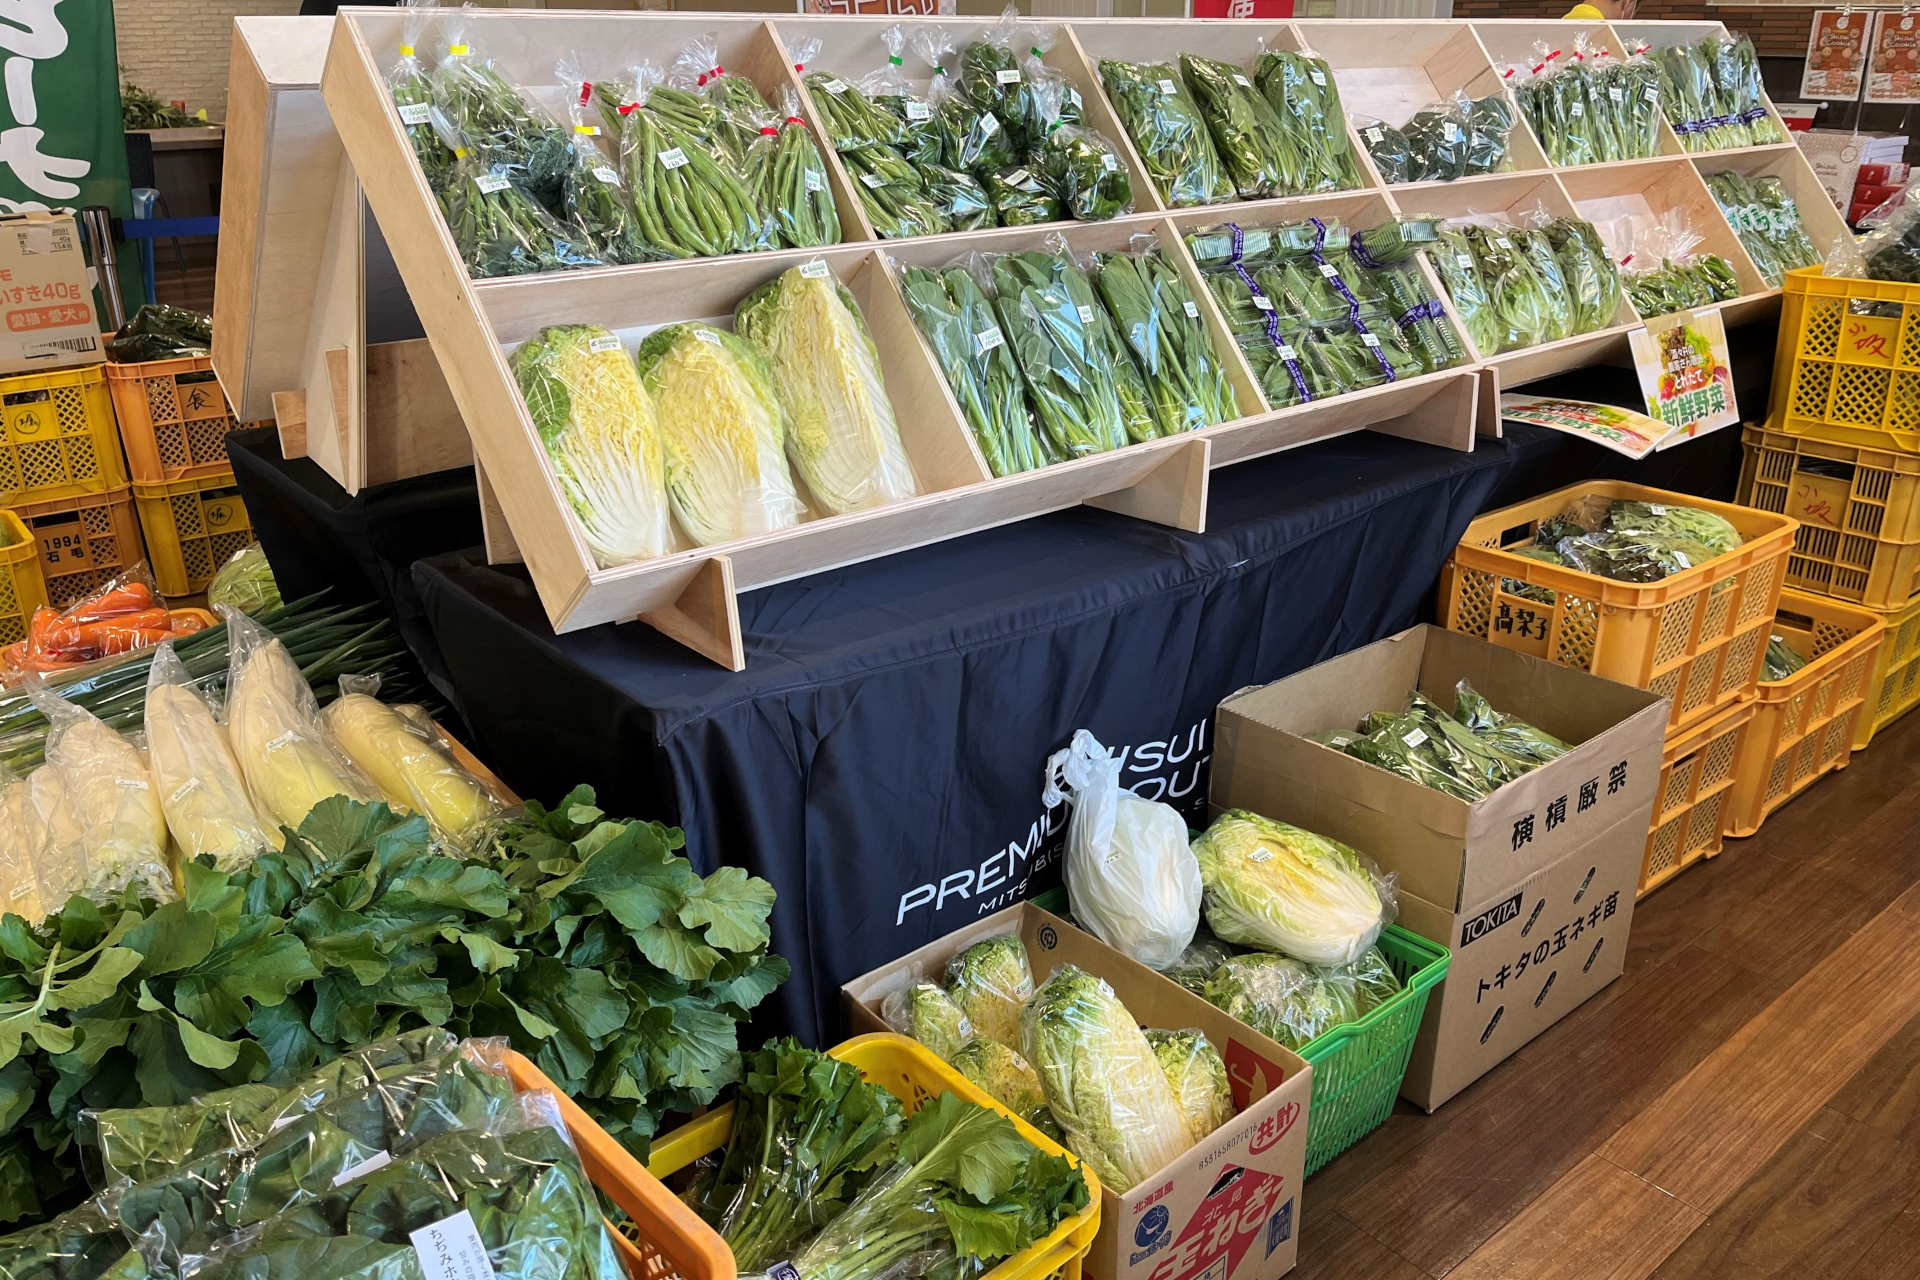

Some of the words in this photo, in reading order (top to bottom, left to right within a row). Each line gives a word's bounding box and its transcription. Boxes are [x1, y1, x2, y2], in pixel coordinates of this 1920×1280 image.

[1675, 369, 1704, 390] とれたて
[1661, 384, 1726, 426] 新鮮野菜
[44, 534, 81, 551] 1994
[1466, 900, 1519, 945] TOKITA
[1476, 891, 1620, 1004] トキタの玉ネギ苗
[1257, 1102, 1294, 1147] 共計
[1133, 1180, 1174, 1215] 北海道産
[1202, 1186, 1243, 1227] 北見
[429, 1229, 460, 1280] ちぢみホ
